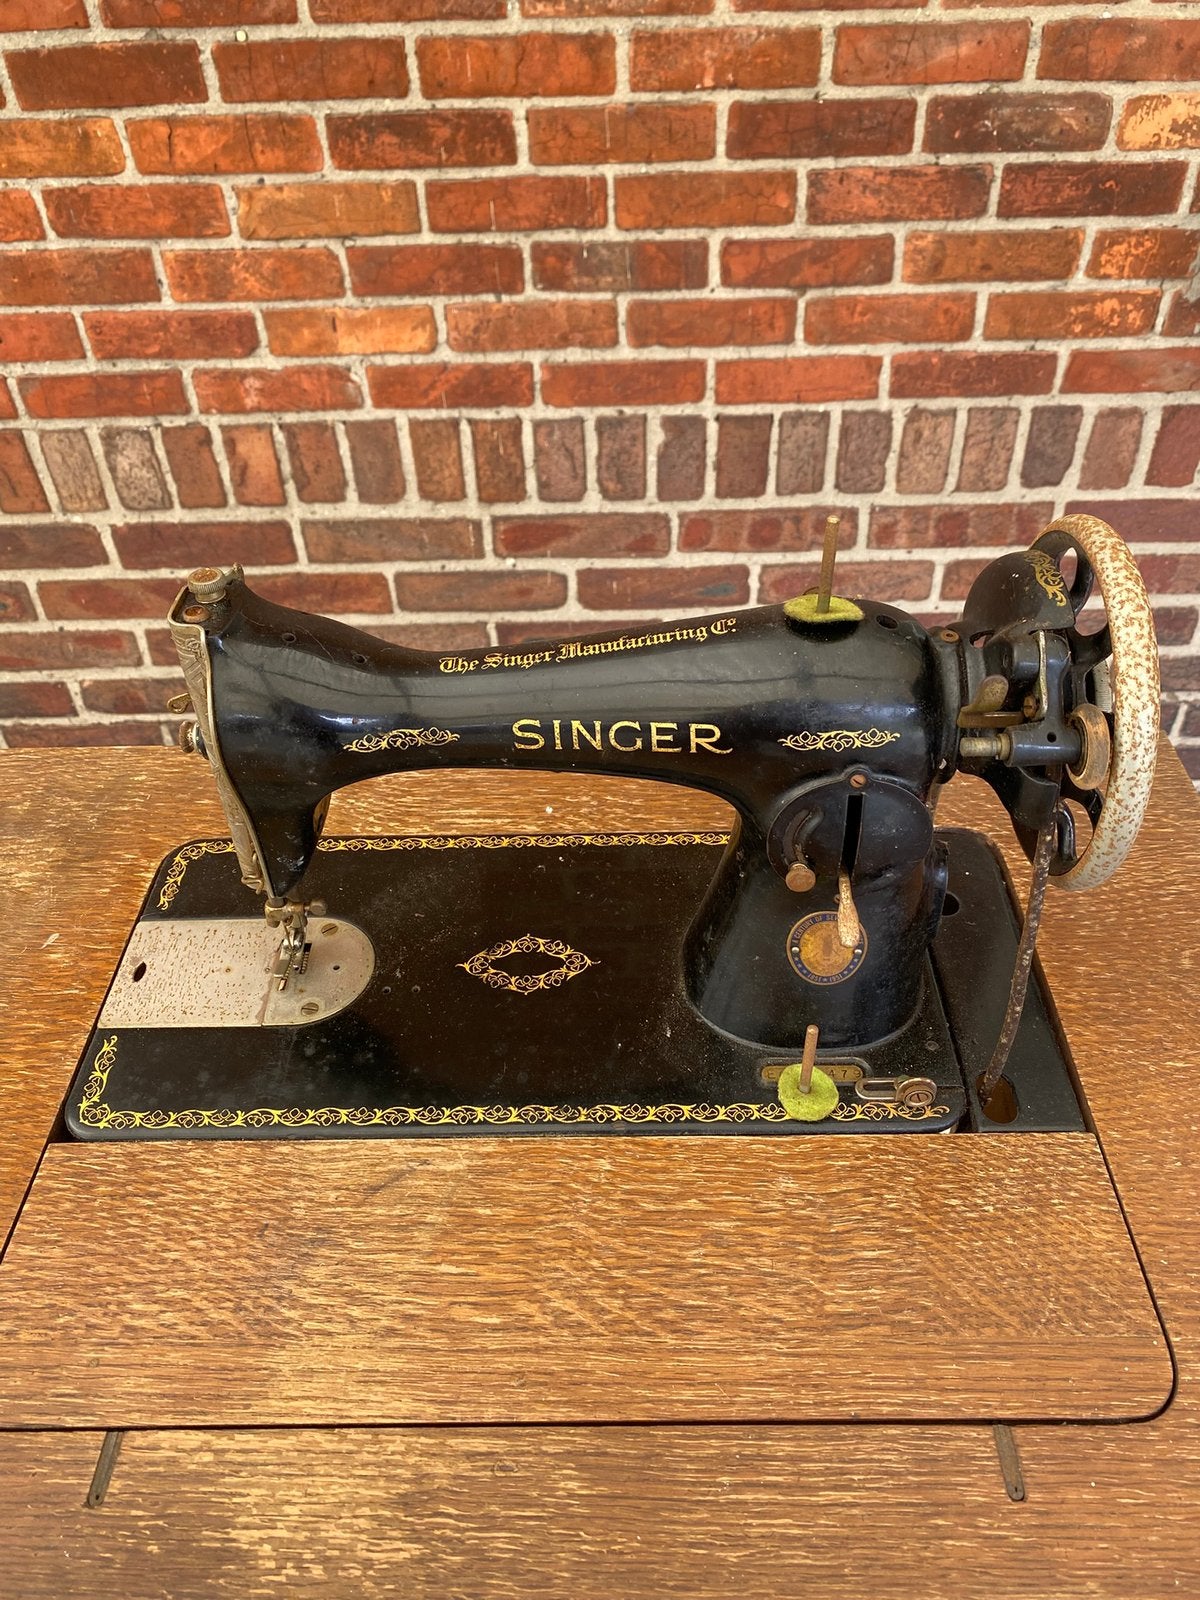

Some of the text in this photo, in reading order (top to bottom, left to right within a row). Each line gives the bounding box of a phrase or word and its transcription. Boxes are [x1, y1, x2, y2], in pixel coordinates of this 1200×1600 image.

[438, 656, 478, 675] The
[480, 650, 556, 671] Singer
[555, 626, 708, 663] Manufacturing
[511, 718, 734, 755] SINGER
